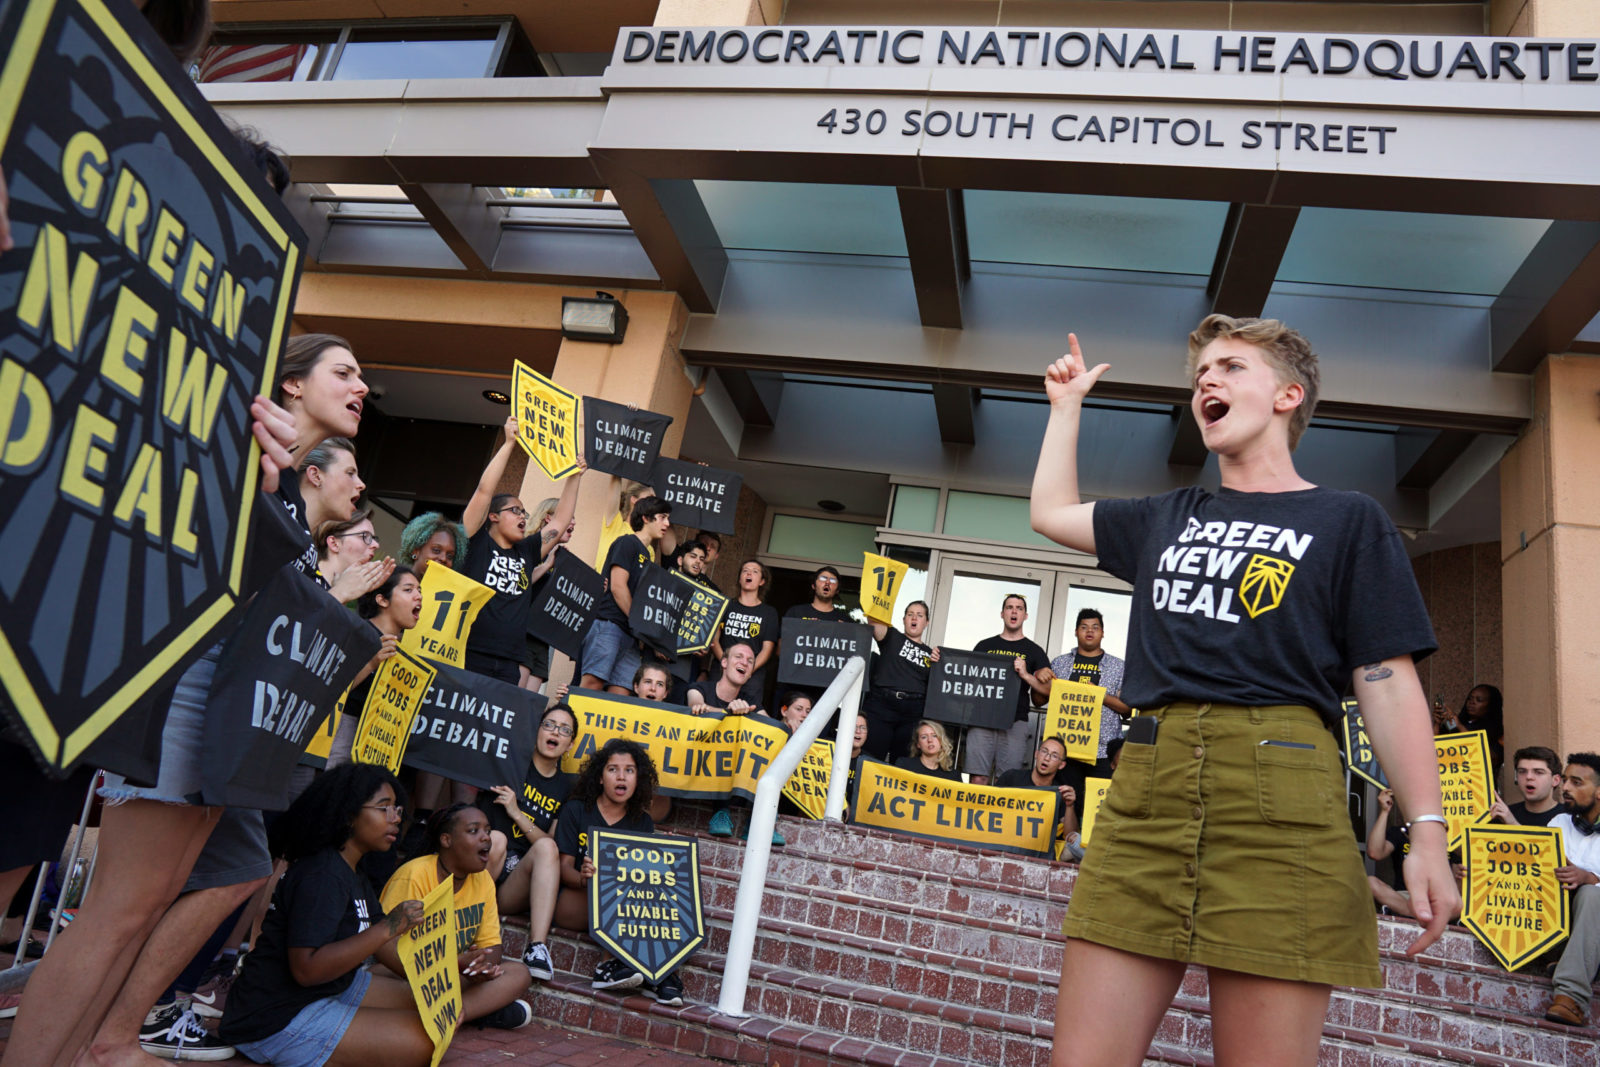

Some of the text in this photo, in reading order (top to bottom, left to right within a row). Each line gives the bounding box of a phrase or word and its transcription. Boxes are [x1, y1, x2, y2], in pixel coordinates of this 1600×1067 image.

[623, 29, 1599, 81] DEMOCRATIC NATIONAL HEADQUARTE
[816, 108, 1397, 155] 430 SOUTH CAPITOL STREET
[62, 130, 246, 342] GREEN
[16, 221, 229, 444] NEW
[525, 391, 565, 421] GREEN
[525, 406, 565, 439] NEW
[596, 419, 652, 445] CLIMATE
[525, 425, 567, 458] DEAL
[595, 437, 647, 464] DEBATE
[0, 357, 200, 556] DEAL
[667, 473, 726, 496] CLIMATE
[664, 489, 722, 513] DEBATE
[1178, 516, 1314, 561] GREEN
[1157, 545, 1248, 580] NEW
[484, 572, 523, 596] DEAL
[556, 575, 595, 611] CLIMATE
[872, 566, 896, 597] 11
[871, 595, 890, 611] YEARS
[1152, 578, 1241, 624] DEAL
[432, 590, 472, 640] 11
[543, 595, 585, 632] DEBATE
[726, 619, 750, 630] NEW
[728, 611, 763, 625] GREEN
[678, 628, 697, 643] URE
[724, 626, 751, 639] DEAL
[795, 635, 857, 652] CLIMATE
[420, 635, 459, 662] YEARS
[793, 652, 846, 670] DEBAT
[944, 662, 1007, 680] CLIMATE
[1073, 663, 1101, 672] UNRI
[391, 662, 418, 689] GOOD
[381, 683, 409, 711] JOBS
[941, 680, 1005, 699] DEBATE
[1061, 692, 1096, 703] GREEN
[379, 709, 392, 723] AND
[421, 685, 516, 729] CLIMATE
[1059, 704, 1094, 717] NEW
[584, 711, 627, 732] THIS
[633, 719, 651, 736] IS
[655, 724, 681, 741] AN
[1057, 717, 1092, 732] DEAL
[410, 714, 510, 760] DEBATE
[662, 746, 733, 778] LIKE
[1436, 745, 1469, 758] OOD
[1439, 760, 1470, 775] OBS
[875, 774, 908, 792] THIS
[913, 782, 927, 795] IS
[931, 786, 951, 800] AN
[956, 790, 1045, 813] EMERGENCY
[1443, 790, 1474, 801] ABLE
[867, 791, 1044, 838] ACT LIKE IT
[1443, 805, 1474, 816] TURE
[616, 846, 675, 865] GOOD
[1486, 840, 1540, 856] GOOD
[616, 866, 676, 887] JOBS
[1487, 859, 1541, 877] JOBS
[627, 889, 667, 901] AND A
[1496, 881, 1532, 892] AND A
[617, 903, 679, 921] LIVABLE
[1486, 894, 1542, 912] LIVABLE
[410, 908, 447, 941] GREEN
[617, 923, 681, 940] FUTURE
[1486, 913, 1542, 931] FUTURE
[414, 934, 447, 975] NEW
[420, 967, 452, 1009] DEAL
